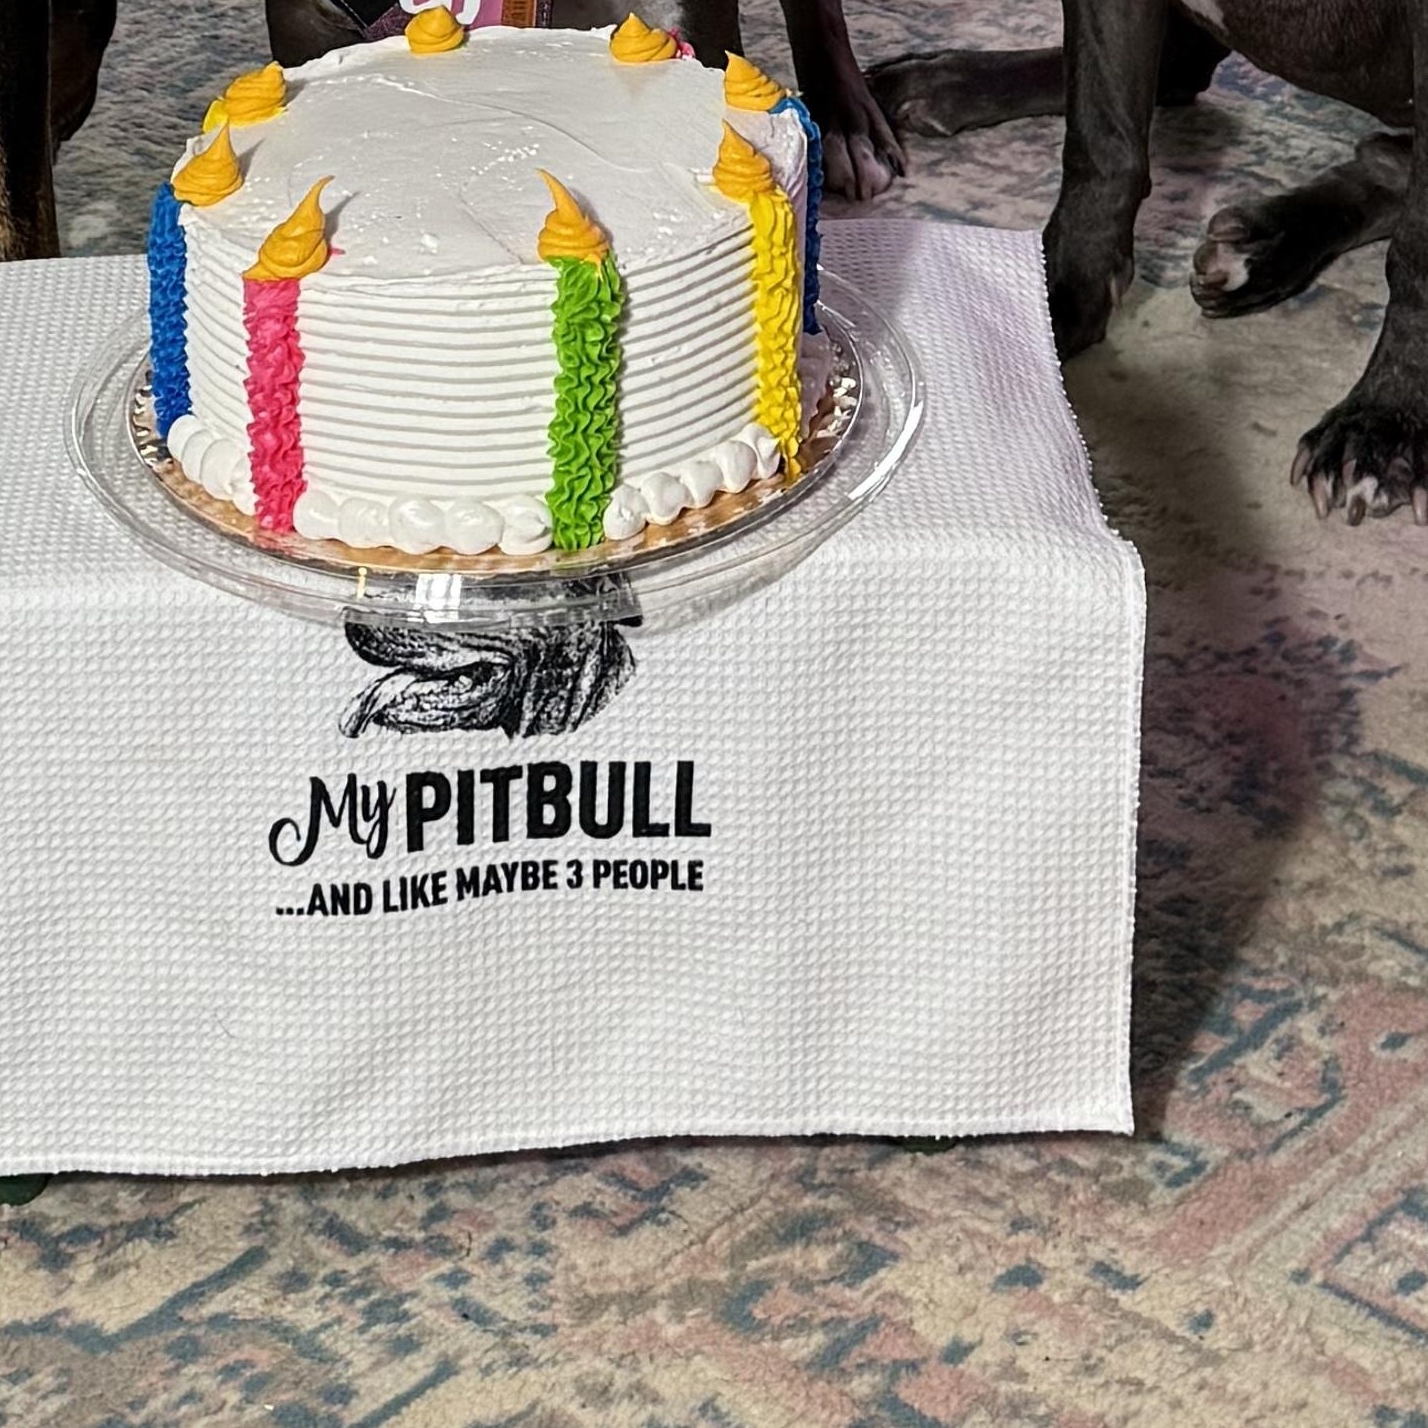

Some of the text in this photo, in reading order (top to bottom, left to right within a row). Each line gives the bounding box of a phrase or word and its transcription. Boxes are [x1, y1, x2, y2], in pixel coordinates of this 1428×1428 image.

[268, 760, 712, 867] My PITBULL
[275, 859, 704, 917] ...AND LIKE MAYBE 3 PEOPLE
